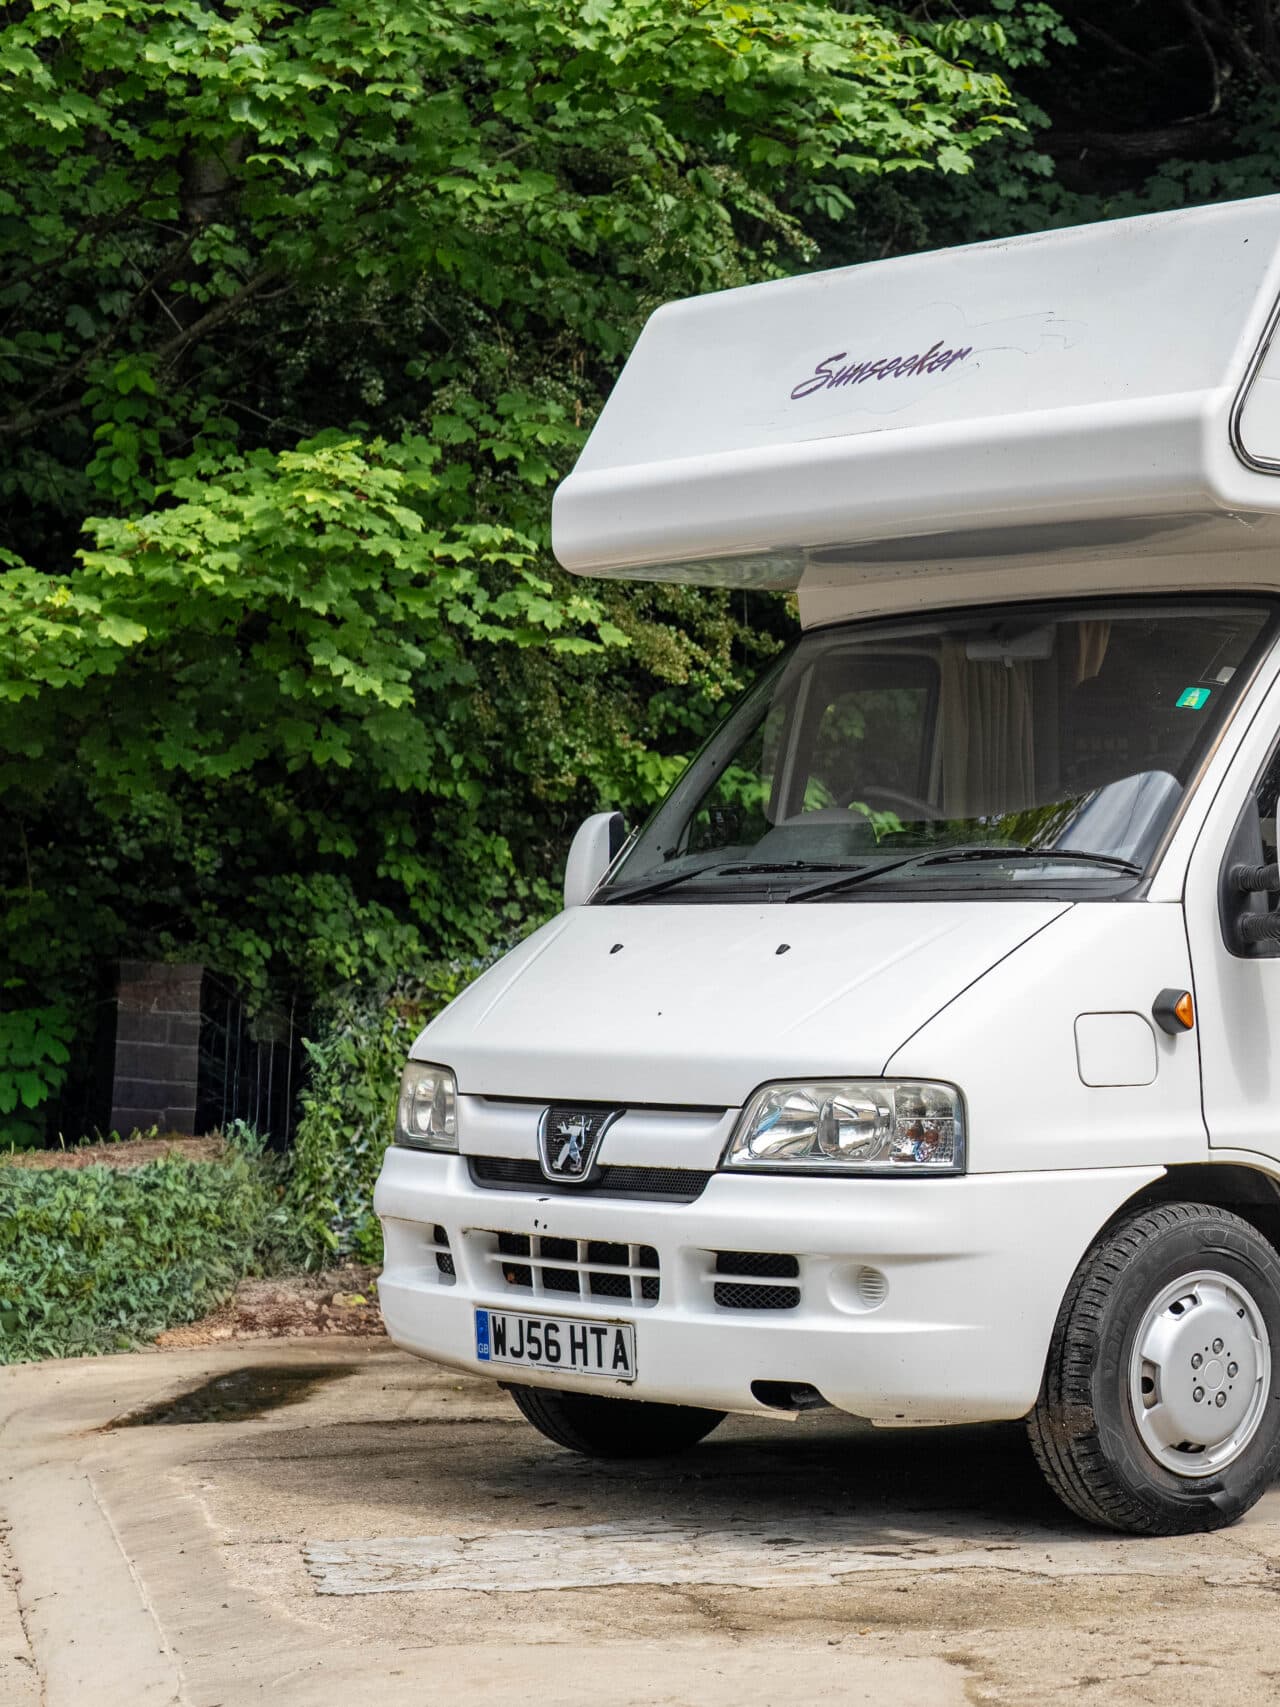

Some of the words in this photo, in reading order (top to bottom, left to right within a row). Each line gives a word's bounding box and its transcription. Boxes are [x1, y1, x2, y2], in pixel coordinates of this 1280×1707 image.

[790, 340, 973, 400] Sunseeker
[478, 1343, 489, 1354] GB
[492, 1315, 561, 1363] WJ56
[570, 1324, 629, 1371] HTA
